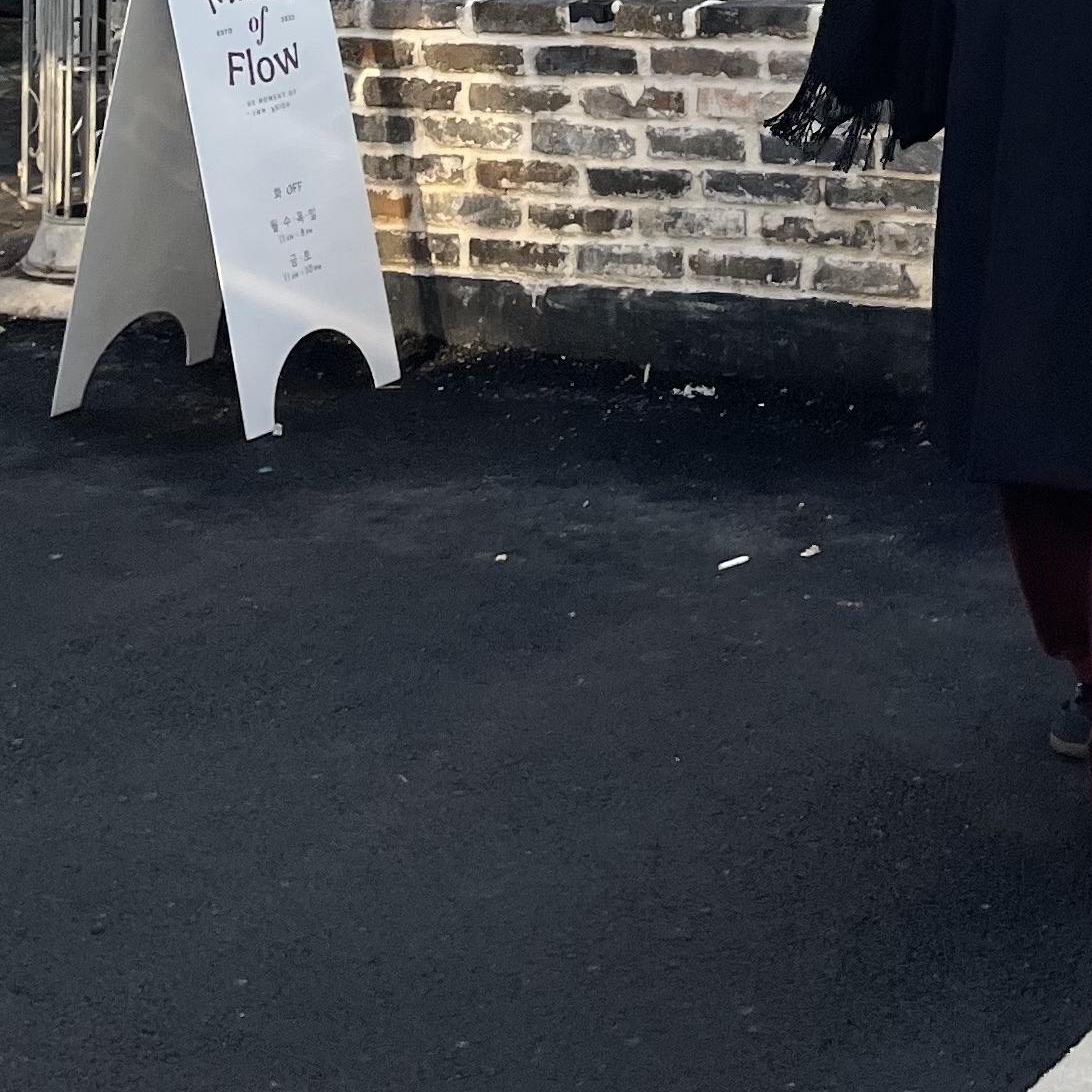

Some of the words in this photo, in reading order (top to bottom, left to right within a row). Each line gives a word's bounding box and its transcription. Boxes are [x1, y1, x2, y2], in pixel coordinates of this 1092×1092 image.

[248, 5, 269, 46] of
[227, 42, 300, 87] Flow
[286, 181, 303, 196] OFF
